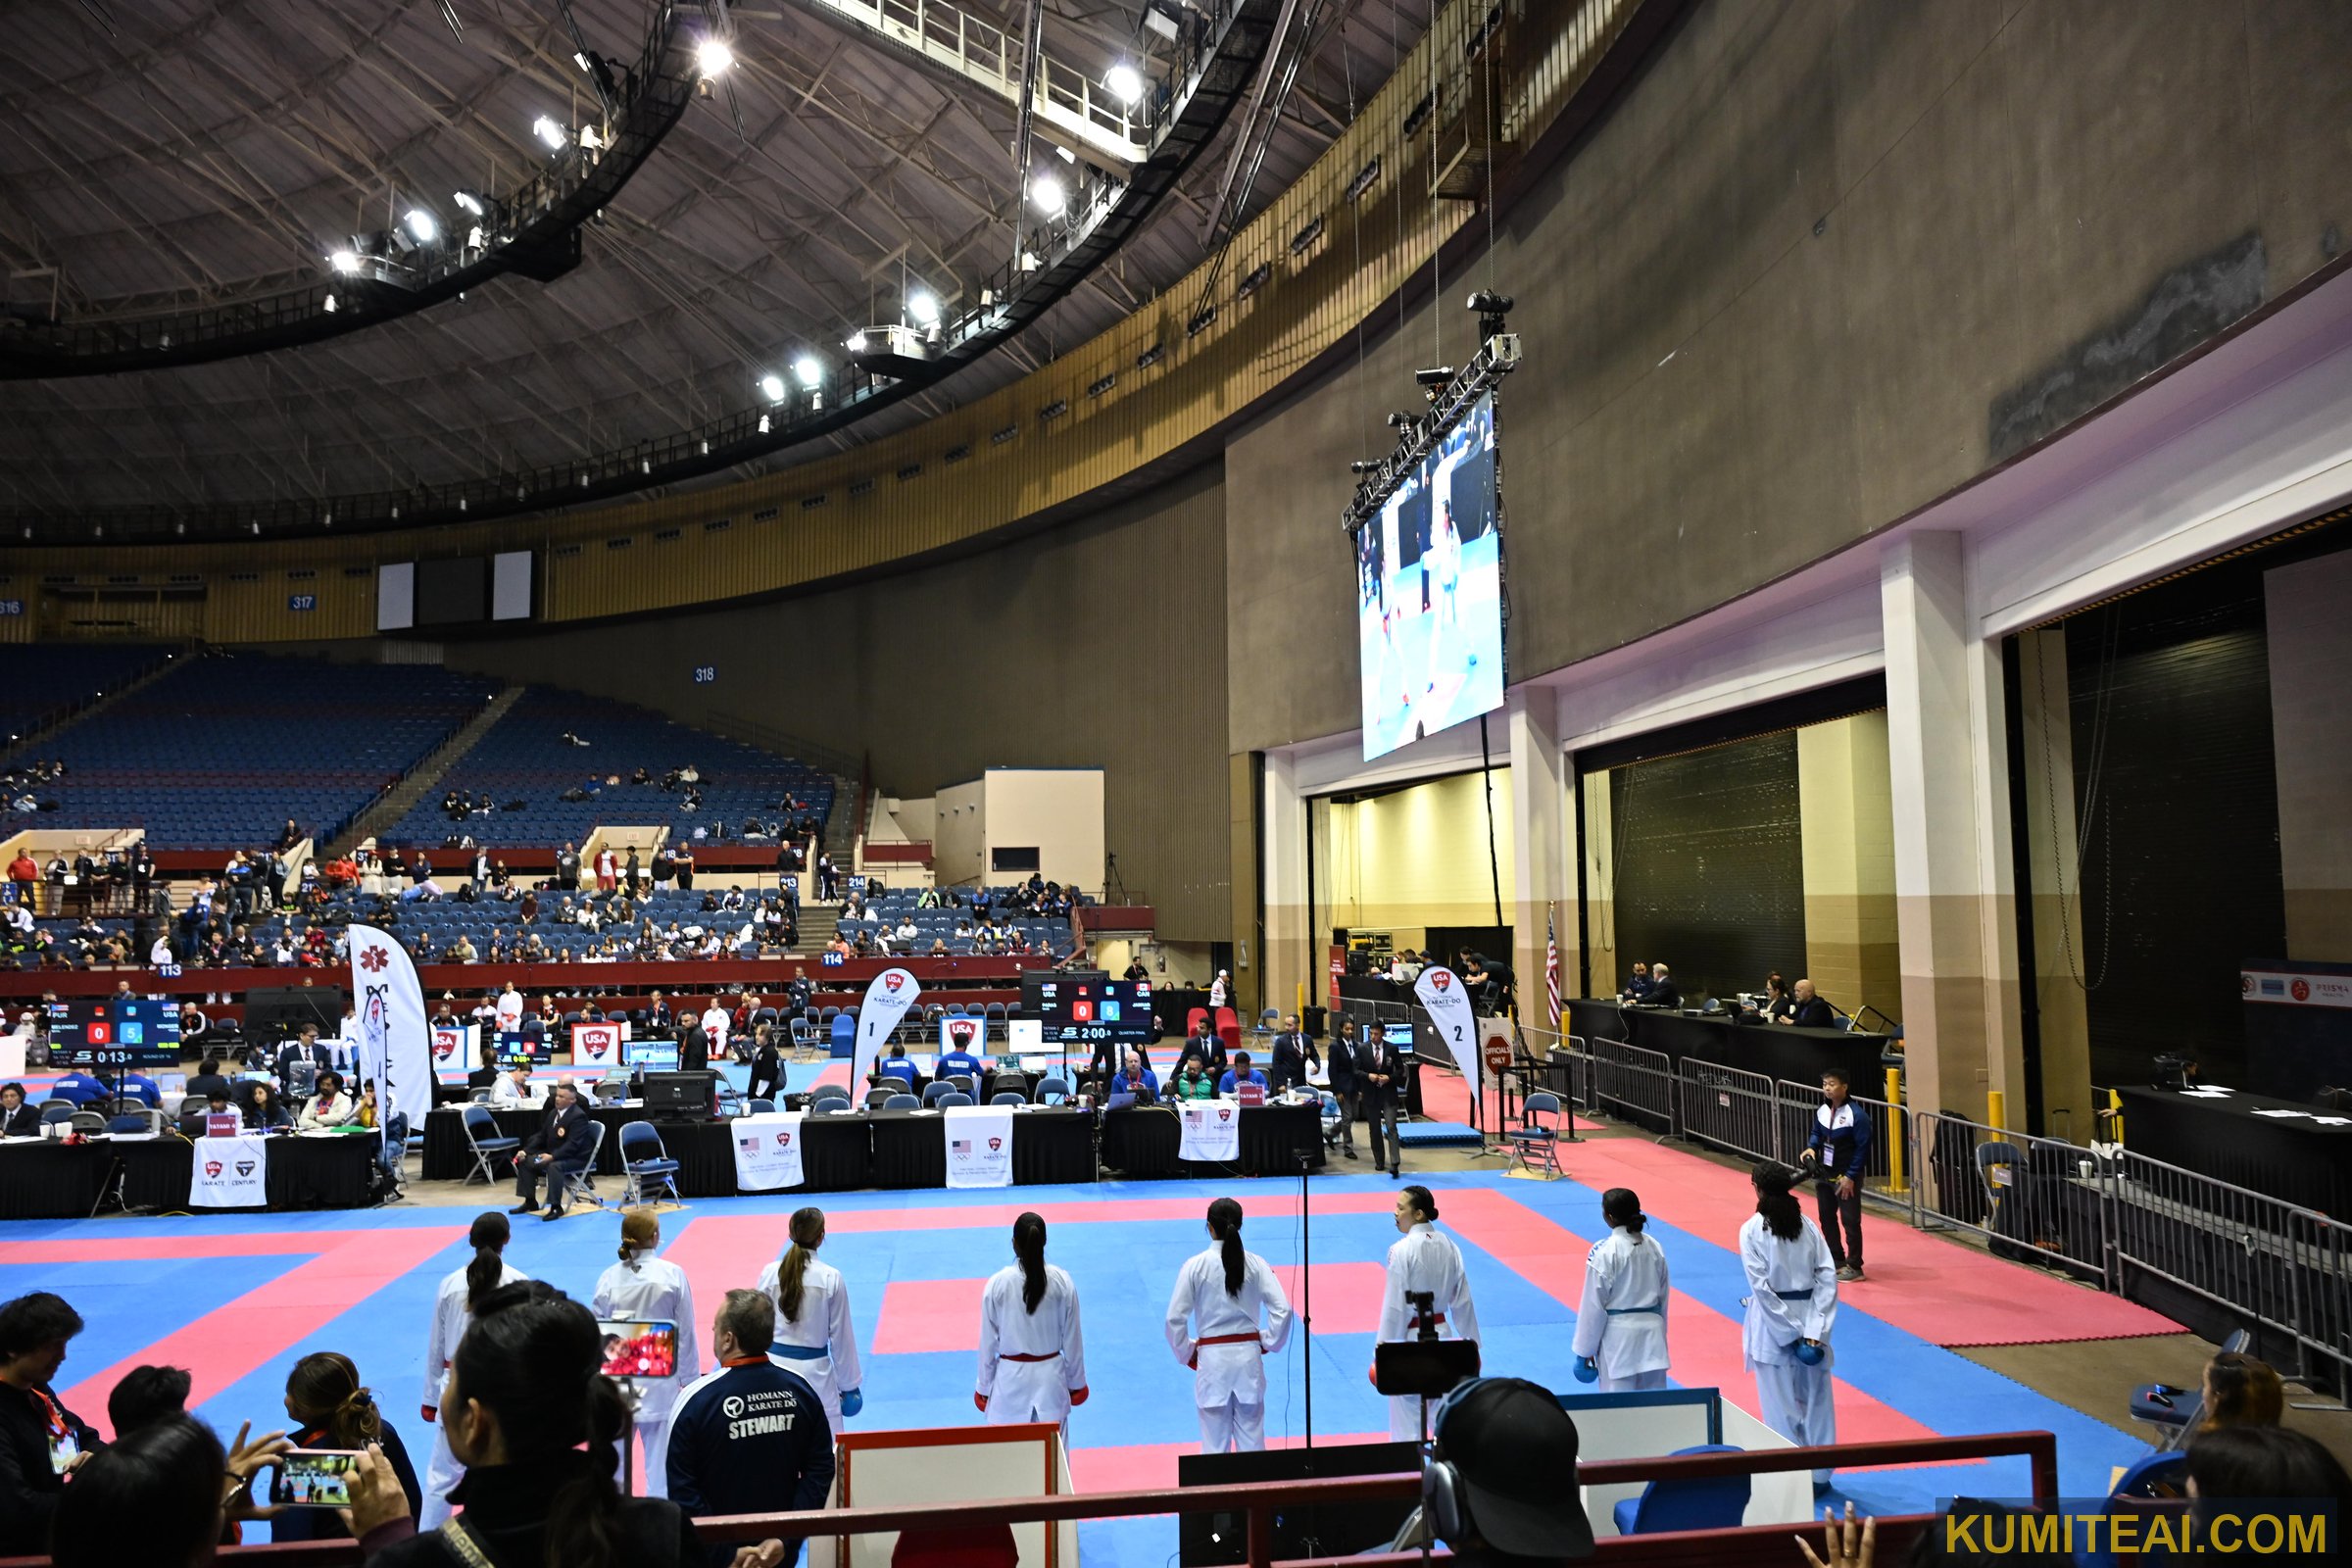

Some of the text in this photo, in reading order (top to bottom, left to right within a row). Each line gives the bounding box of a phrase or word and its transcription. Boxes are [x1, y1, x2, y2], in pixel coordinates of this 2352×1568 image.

[293, 596, 313, 609] 317
[696, 666, 714, 682] 318
[849, 877, 864, 887] 214
[823, 954, 843, 964] 114
[160, 964, 182, 976] 113
[887, 975, 902, 984] USA
[1079, 1005, 1087, 1017] 0
[1105, 1005, 1114, 1017] 8
[94, 1027, 104, 1040] 0
[126, 1027, 136, 1039] 5
[868, 1021, 875, 1037] 1
[952, 1024, 973, 1034] USA
[1453, 1025, 1463, 1042] 2
[585, 1035, 608, 1044] USA
[1486, 1046, 1510, 1055] OFFICIALS
[1491, 1056, 1506, 1065] ONLY
[748, 1391, 793, 1401] HOMANN
[748, 1400, 783, 1411] KARATE
[728, 1414, 795, 1440] STEWART
